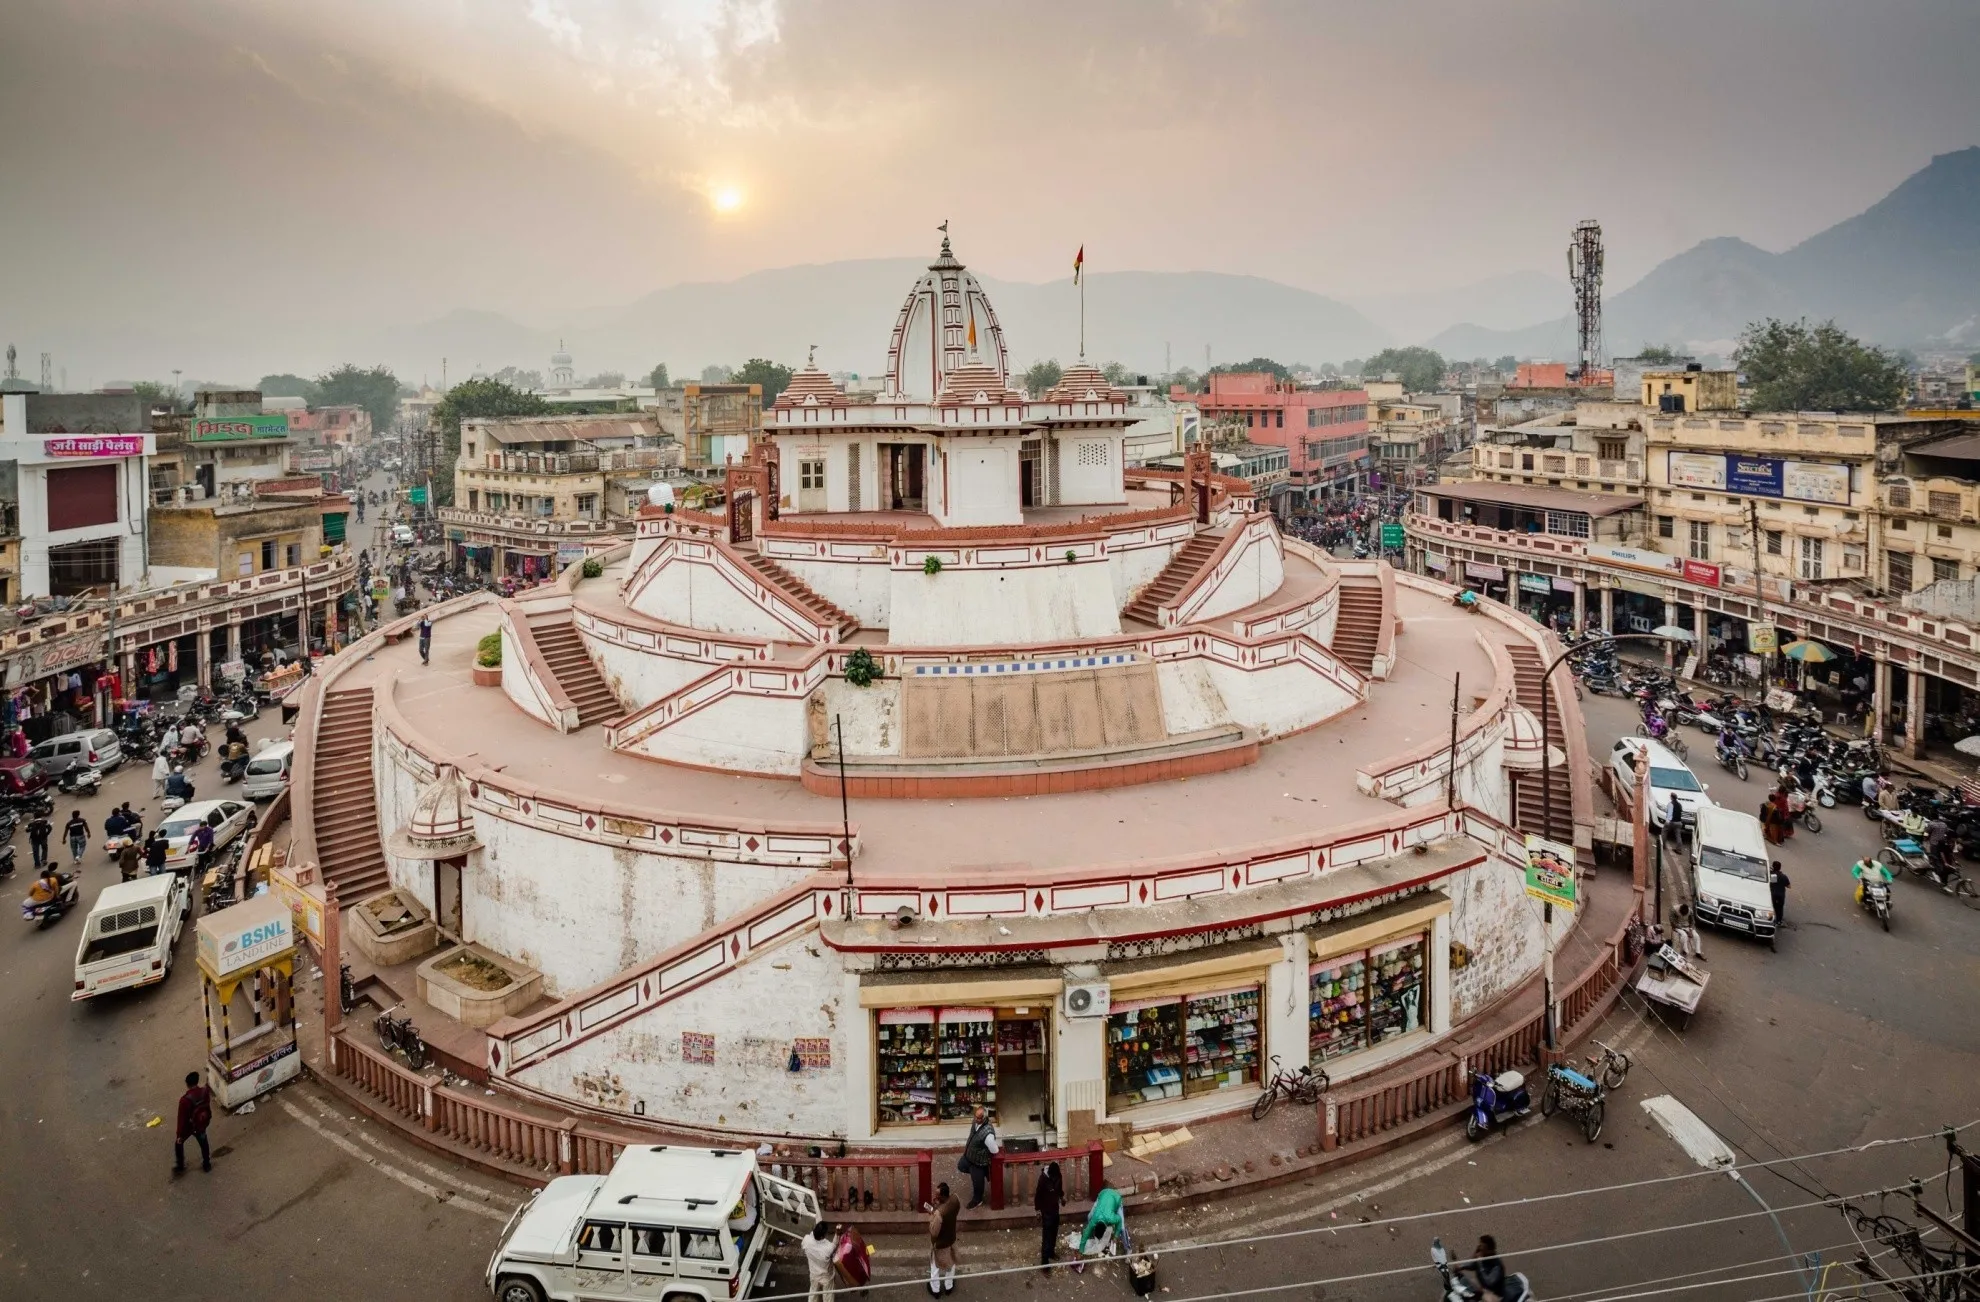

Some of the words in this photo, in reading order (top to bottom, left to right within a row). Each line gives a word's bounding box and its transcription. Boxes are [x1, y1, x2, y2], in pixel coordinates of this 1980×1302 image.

[53, 439, 76, 451] जरी
[78, 439, 104, 452] साड़ी
[1611, 550, 1637, 560] PHILIPS
[41, 662, 64, 673] SHOW
[66, 654, 89, 666] ROOM
[44, 640, 95, 667] DCM
[241, 920, 286, 949] BSNL
[226, 937, 285, 967] LANDLINE
